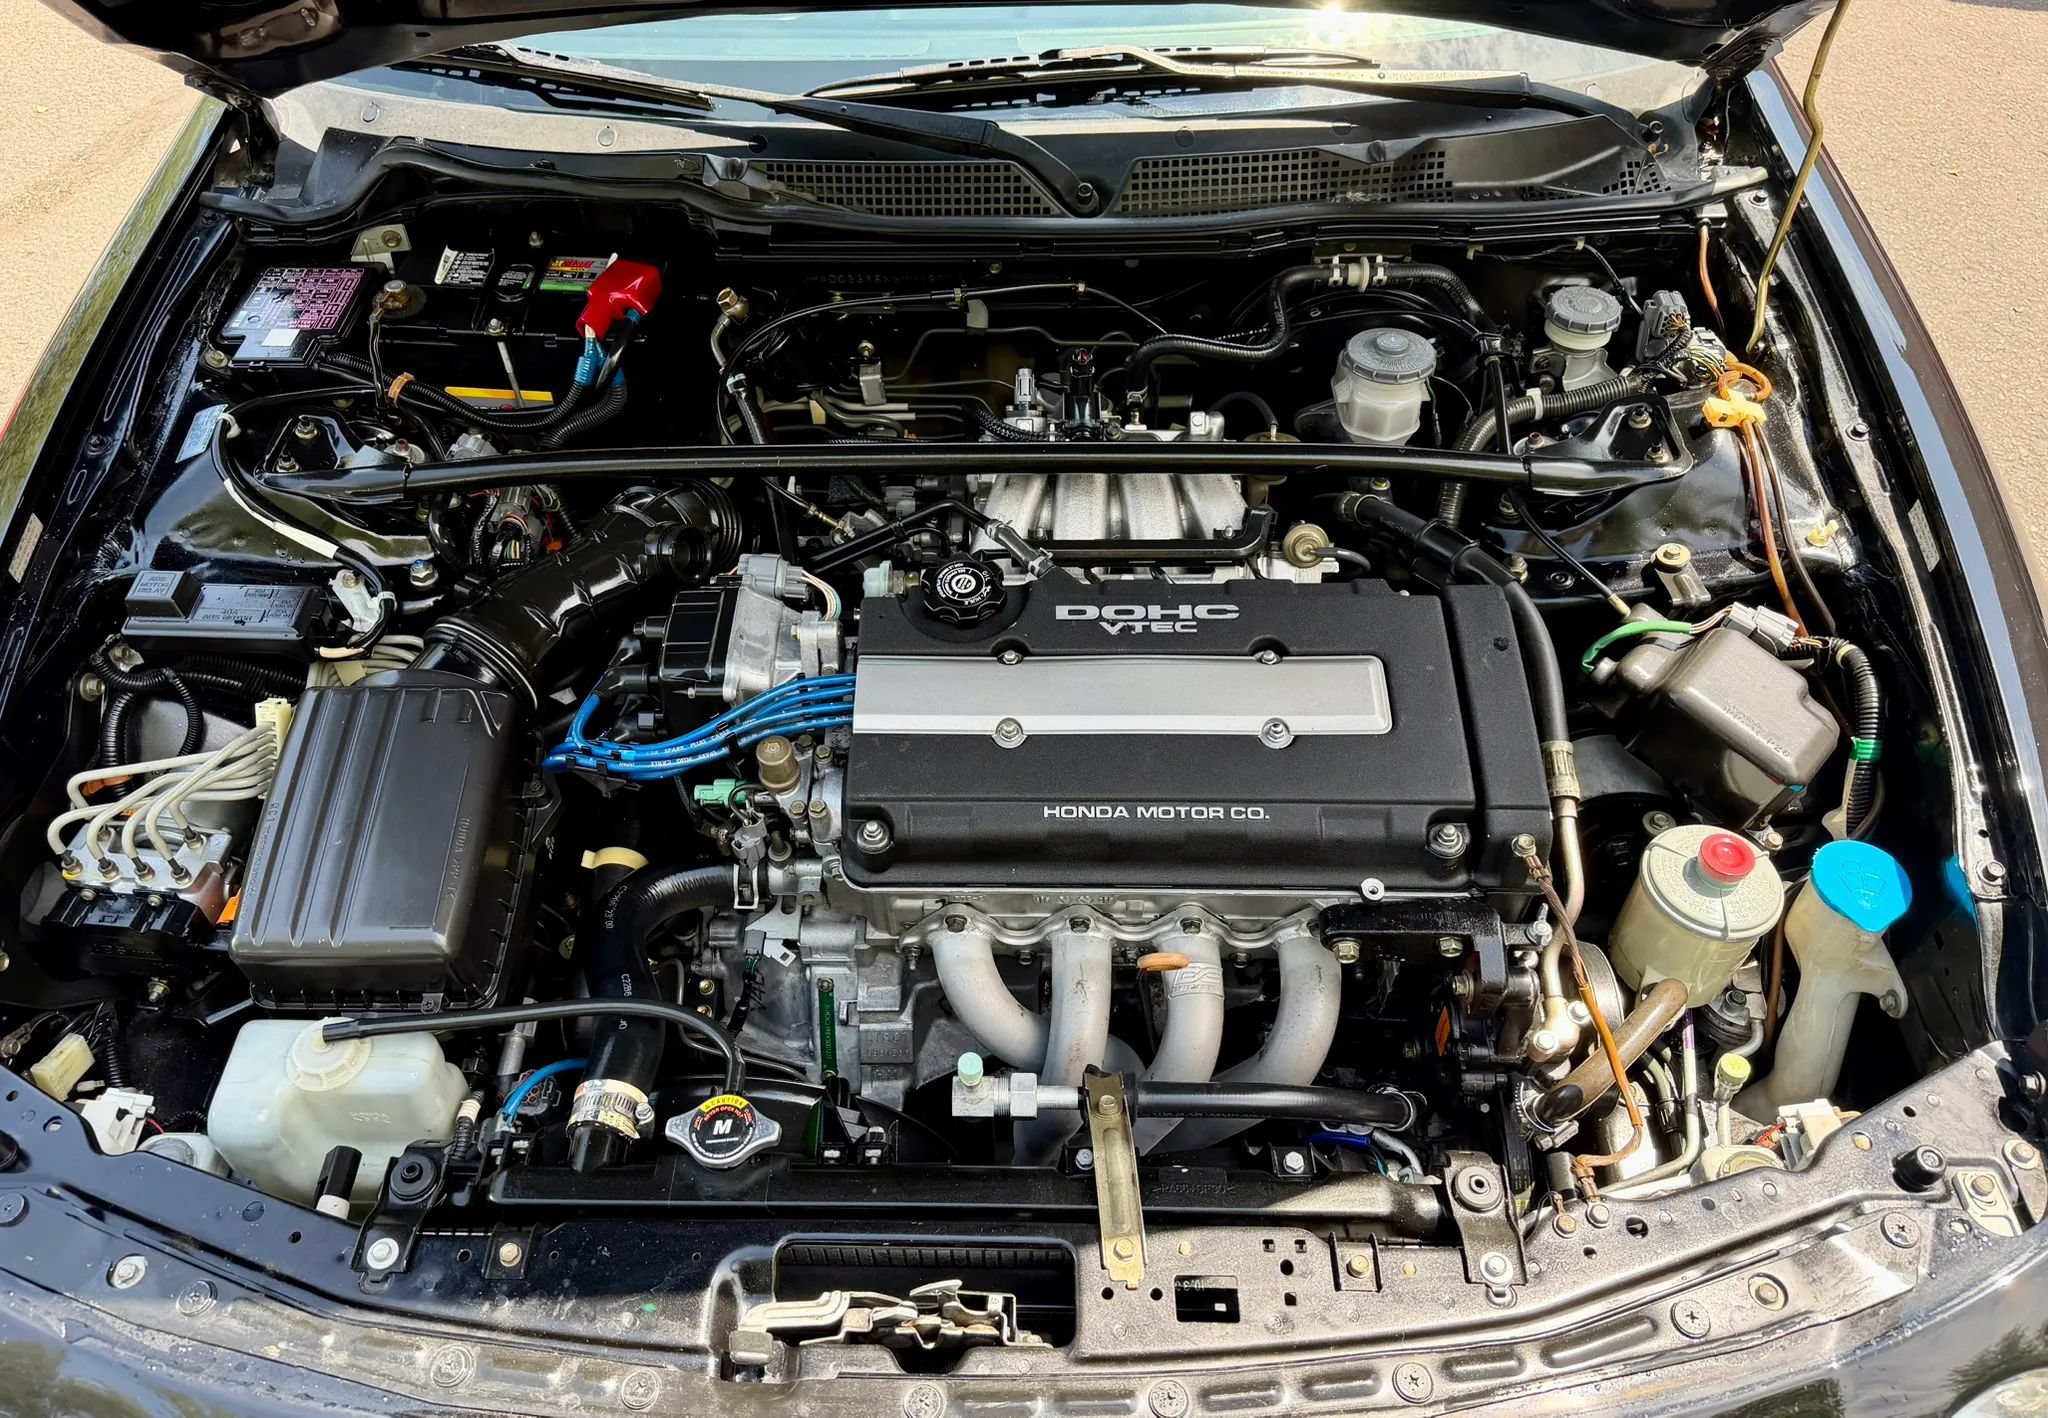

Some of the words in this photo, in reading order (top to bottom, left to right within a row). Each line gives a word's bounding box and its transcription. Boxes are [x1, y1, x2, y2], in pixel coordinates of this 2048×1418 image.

[1056, 605, 1240, 620] DOHC
[1098, 621, 1198, 635] VTEC
[664, 744, 685, 755] SPARK
[1043, 806, 1129, 820] HONDA
[1136, 806, 1225, 820] MOTOR
[1231, 806, 1270, 820] CO.
[711, 1096, 743, 1107] CAUTION
[713, 1118, 733, 1136] M
